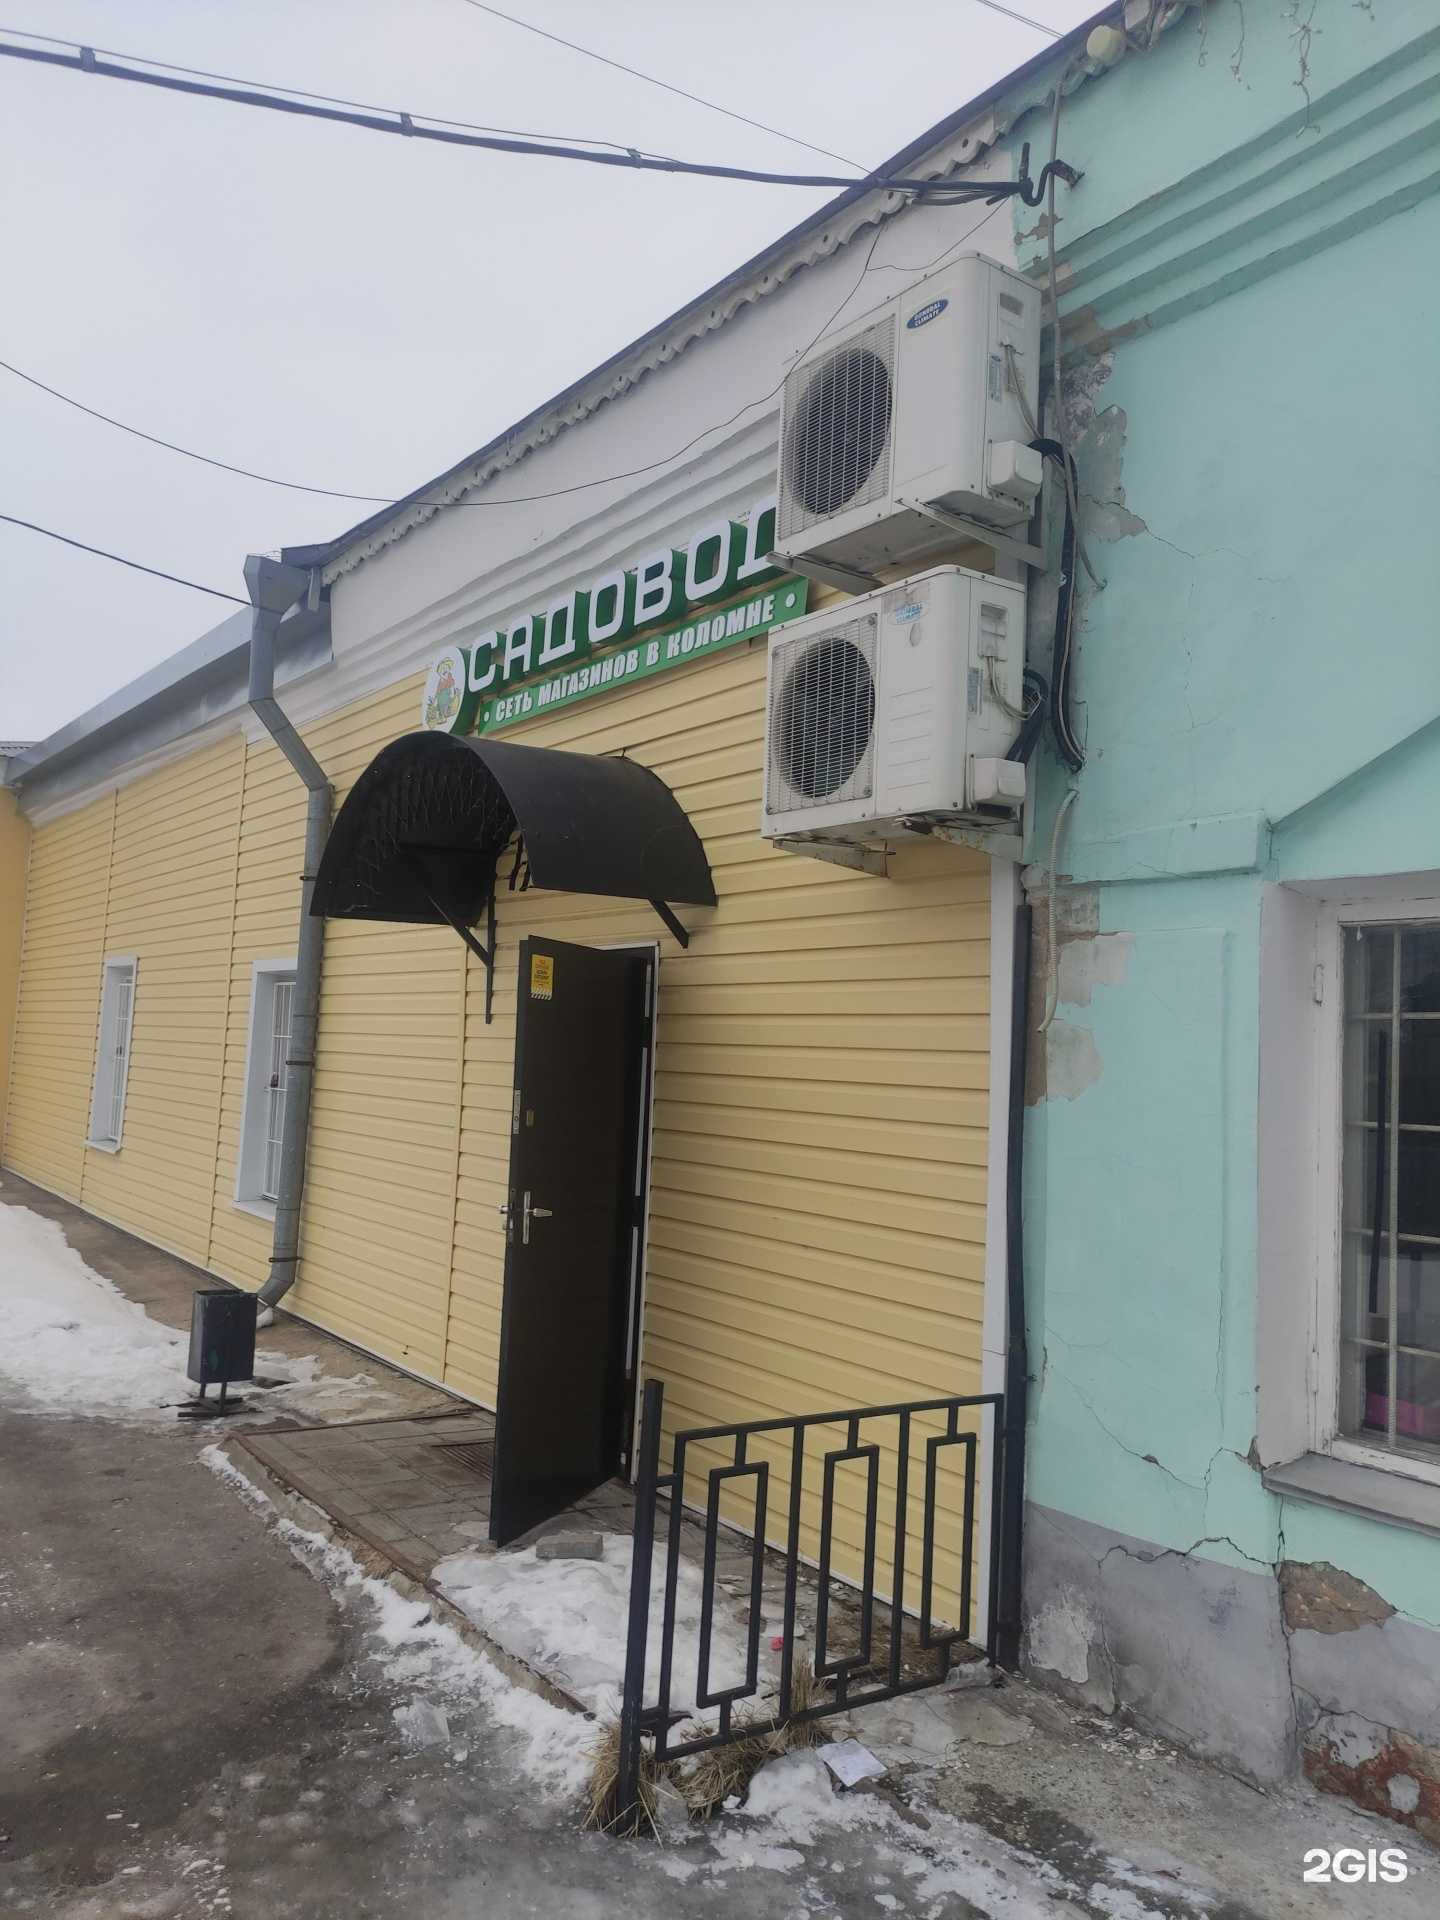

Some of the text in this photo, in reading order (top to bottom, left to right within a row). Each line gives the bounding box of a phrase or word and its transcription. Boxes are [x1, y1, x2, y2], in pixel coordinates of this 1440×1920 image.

[495, 594, 775, 722] СЕТЬ МАГАЗИНОВ В КОЛОМНЕ
